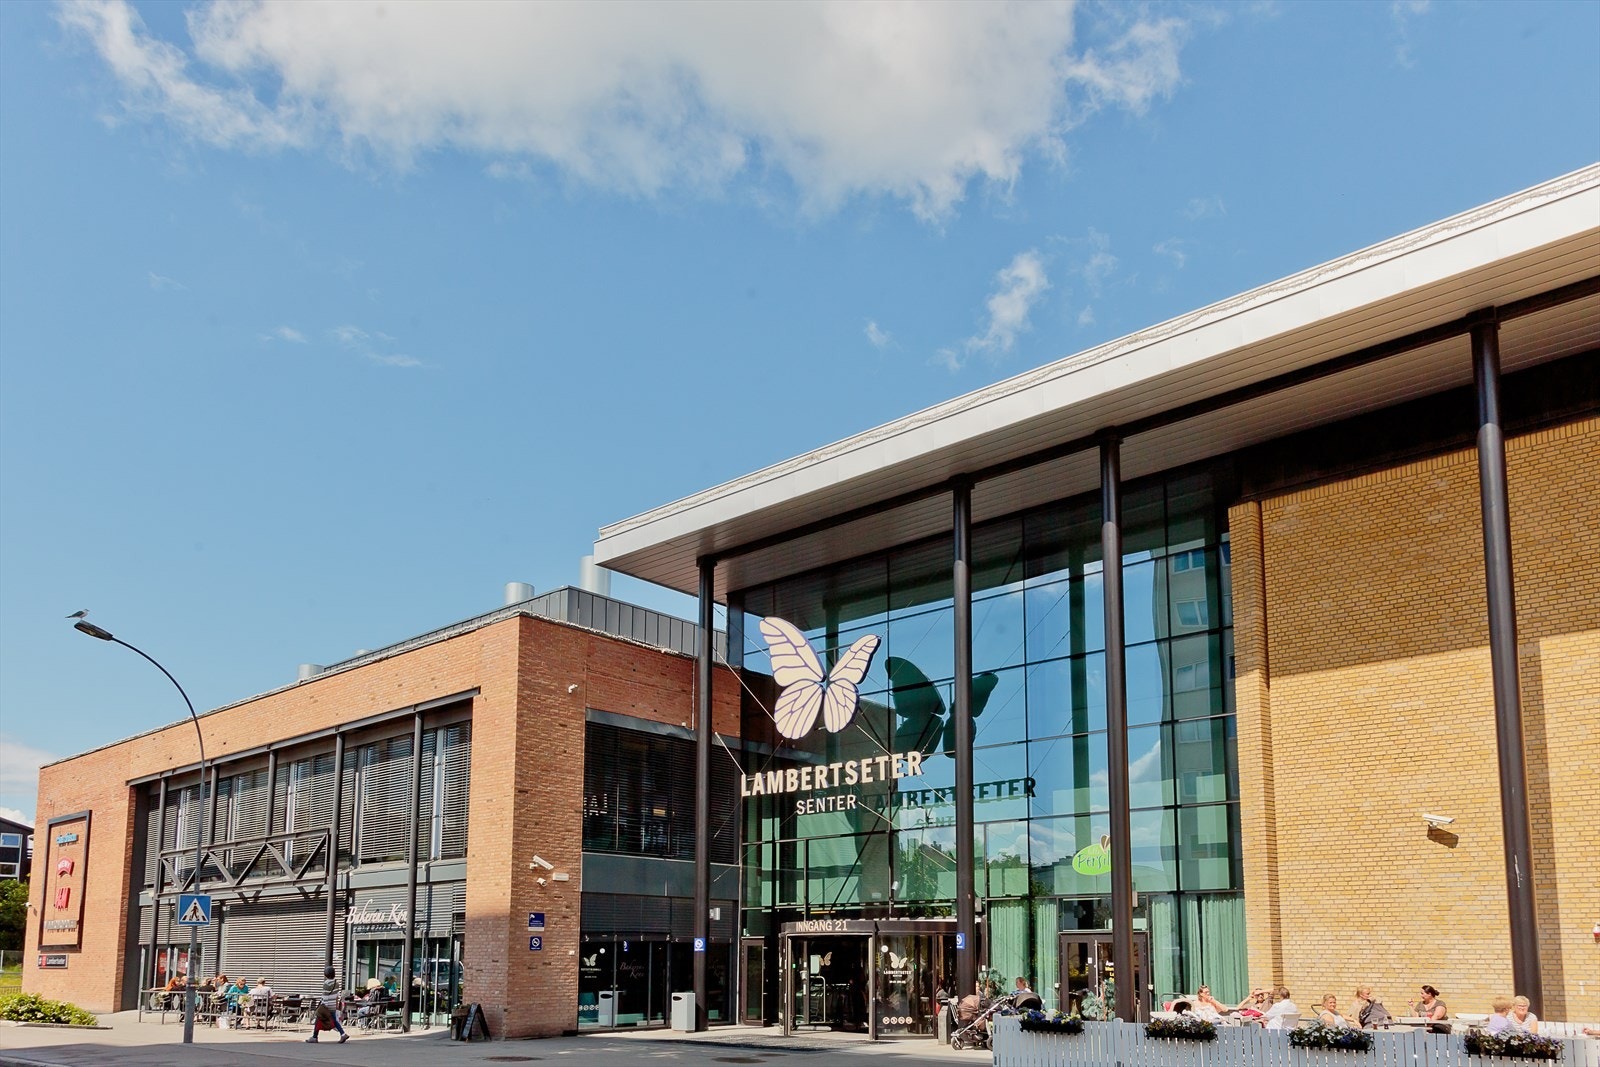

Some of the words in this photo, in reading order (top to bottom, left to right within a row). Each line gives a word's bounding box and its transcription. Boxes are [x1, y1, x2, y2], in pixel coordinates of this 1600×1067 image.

[741, 750, 924, 797] LAMBERTSETER
[796, 794, 858, 815] SENTER
[796, 921, 833, 932] INNGANG
[835, 920, 848, 931] 21
